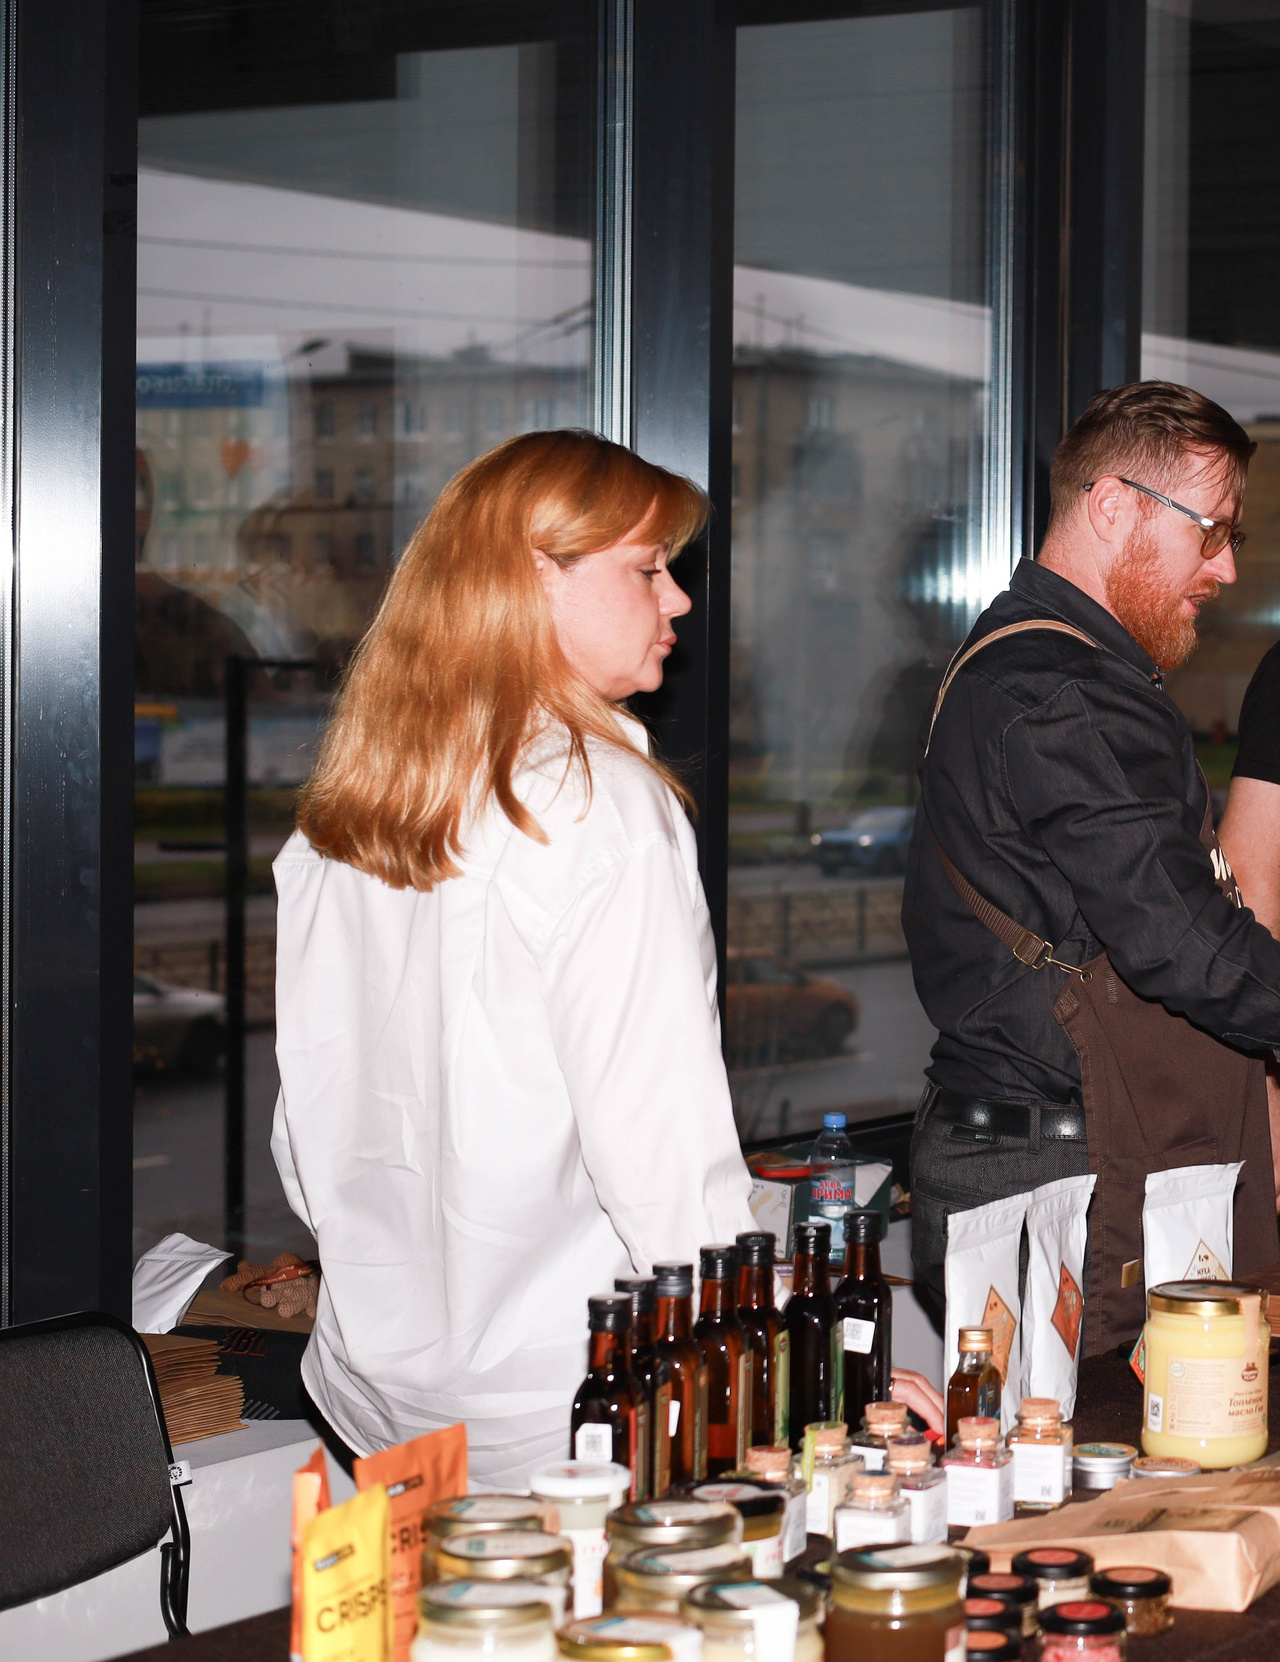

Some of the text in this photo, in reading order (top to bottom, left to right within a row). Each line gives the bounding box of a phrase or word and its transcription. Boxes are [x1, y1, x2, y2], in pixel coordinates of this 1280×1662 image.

[819, 1180, 842, 1188] АКВА
[811, 1187, 852, 1201] ПРИМА
[219, 1329, 268, 1357] JBL
